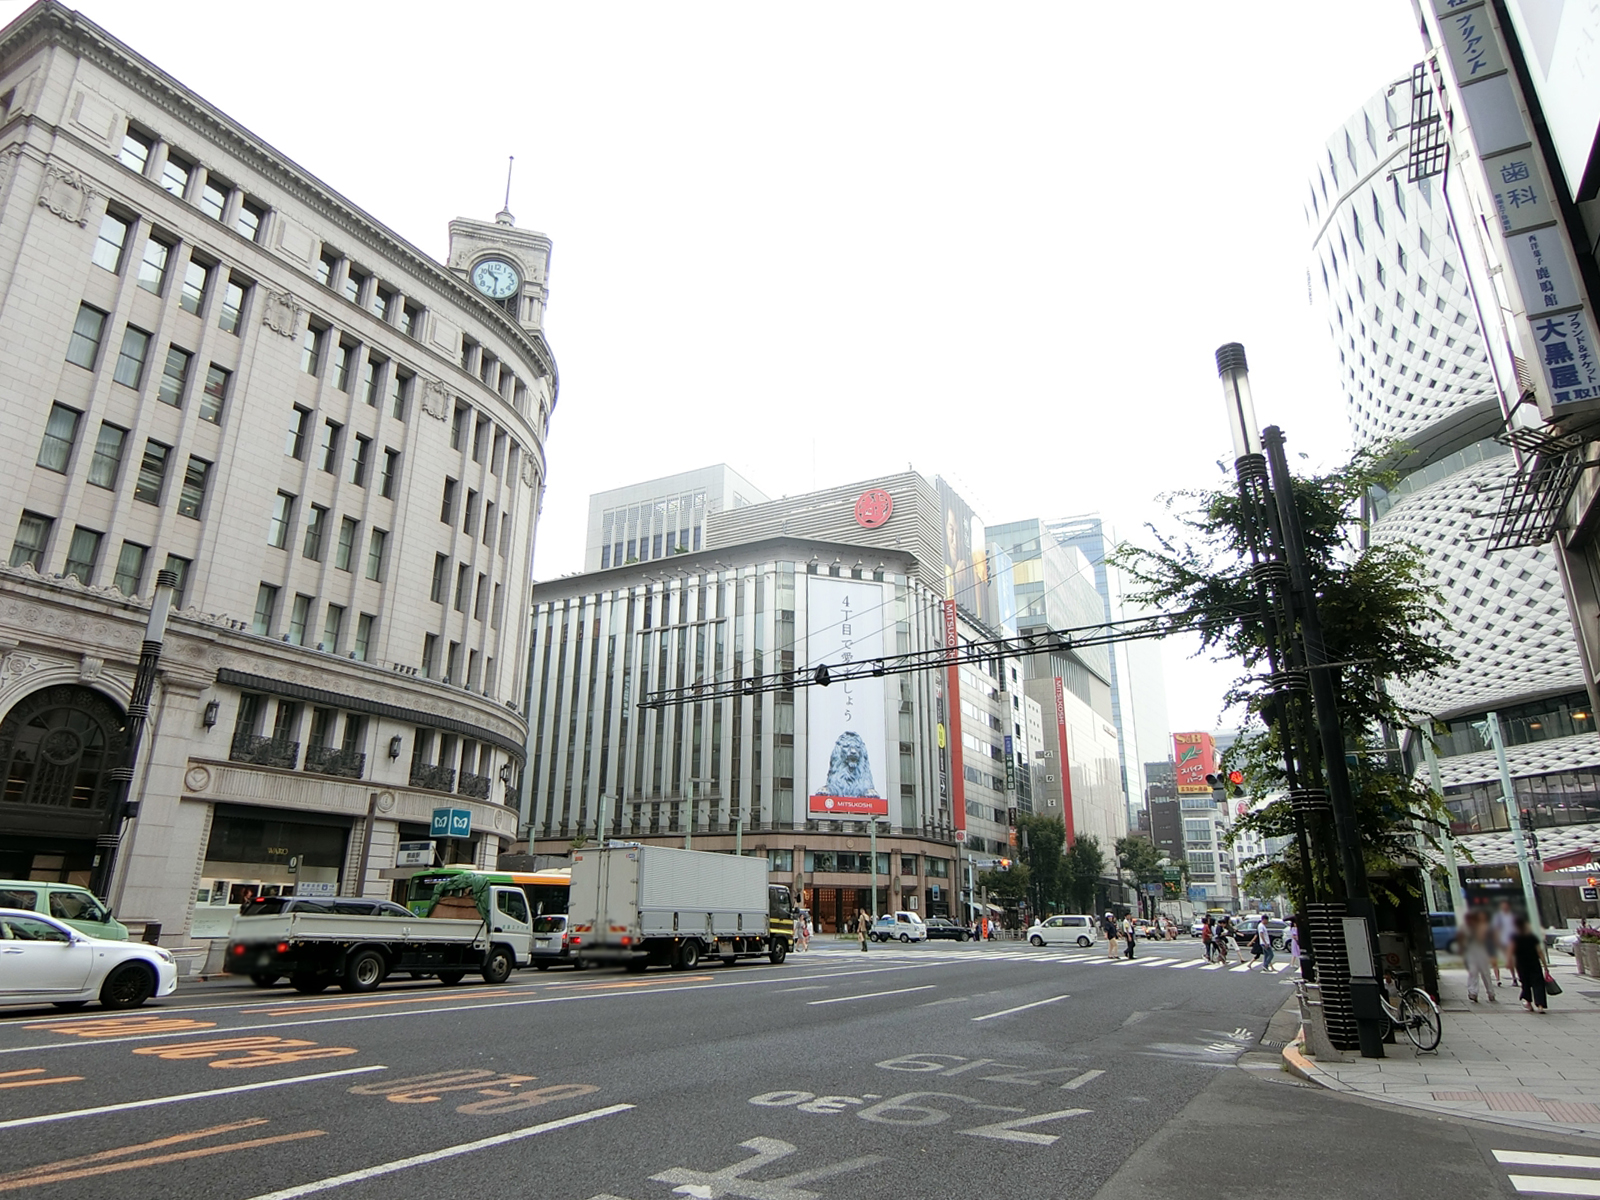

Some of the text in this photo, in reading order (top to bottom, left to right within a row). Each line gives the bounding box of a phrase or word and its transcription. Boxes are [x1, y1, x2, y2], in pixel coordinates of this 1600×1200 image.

[1500, 160, 1537, 209] 歯科
[1535, 267, 1558, 307] 鹿鳴館
[1536, 318, 1582, 389] 大黒屋
[1567, 312, 1597, 384] ブランド&チケット
[837, 801, 873, 809] MITSUKOSHI
[131, 1035, 359, 1069] 8-20
